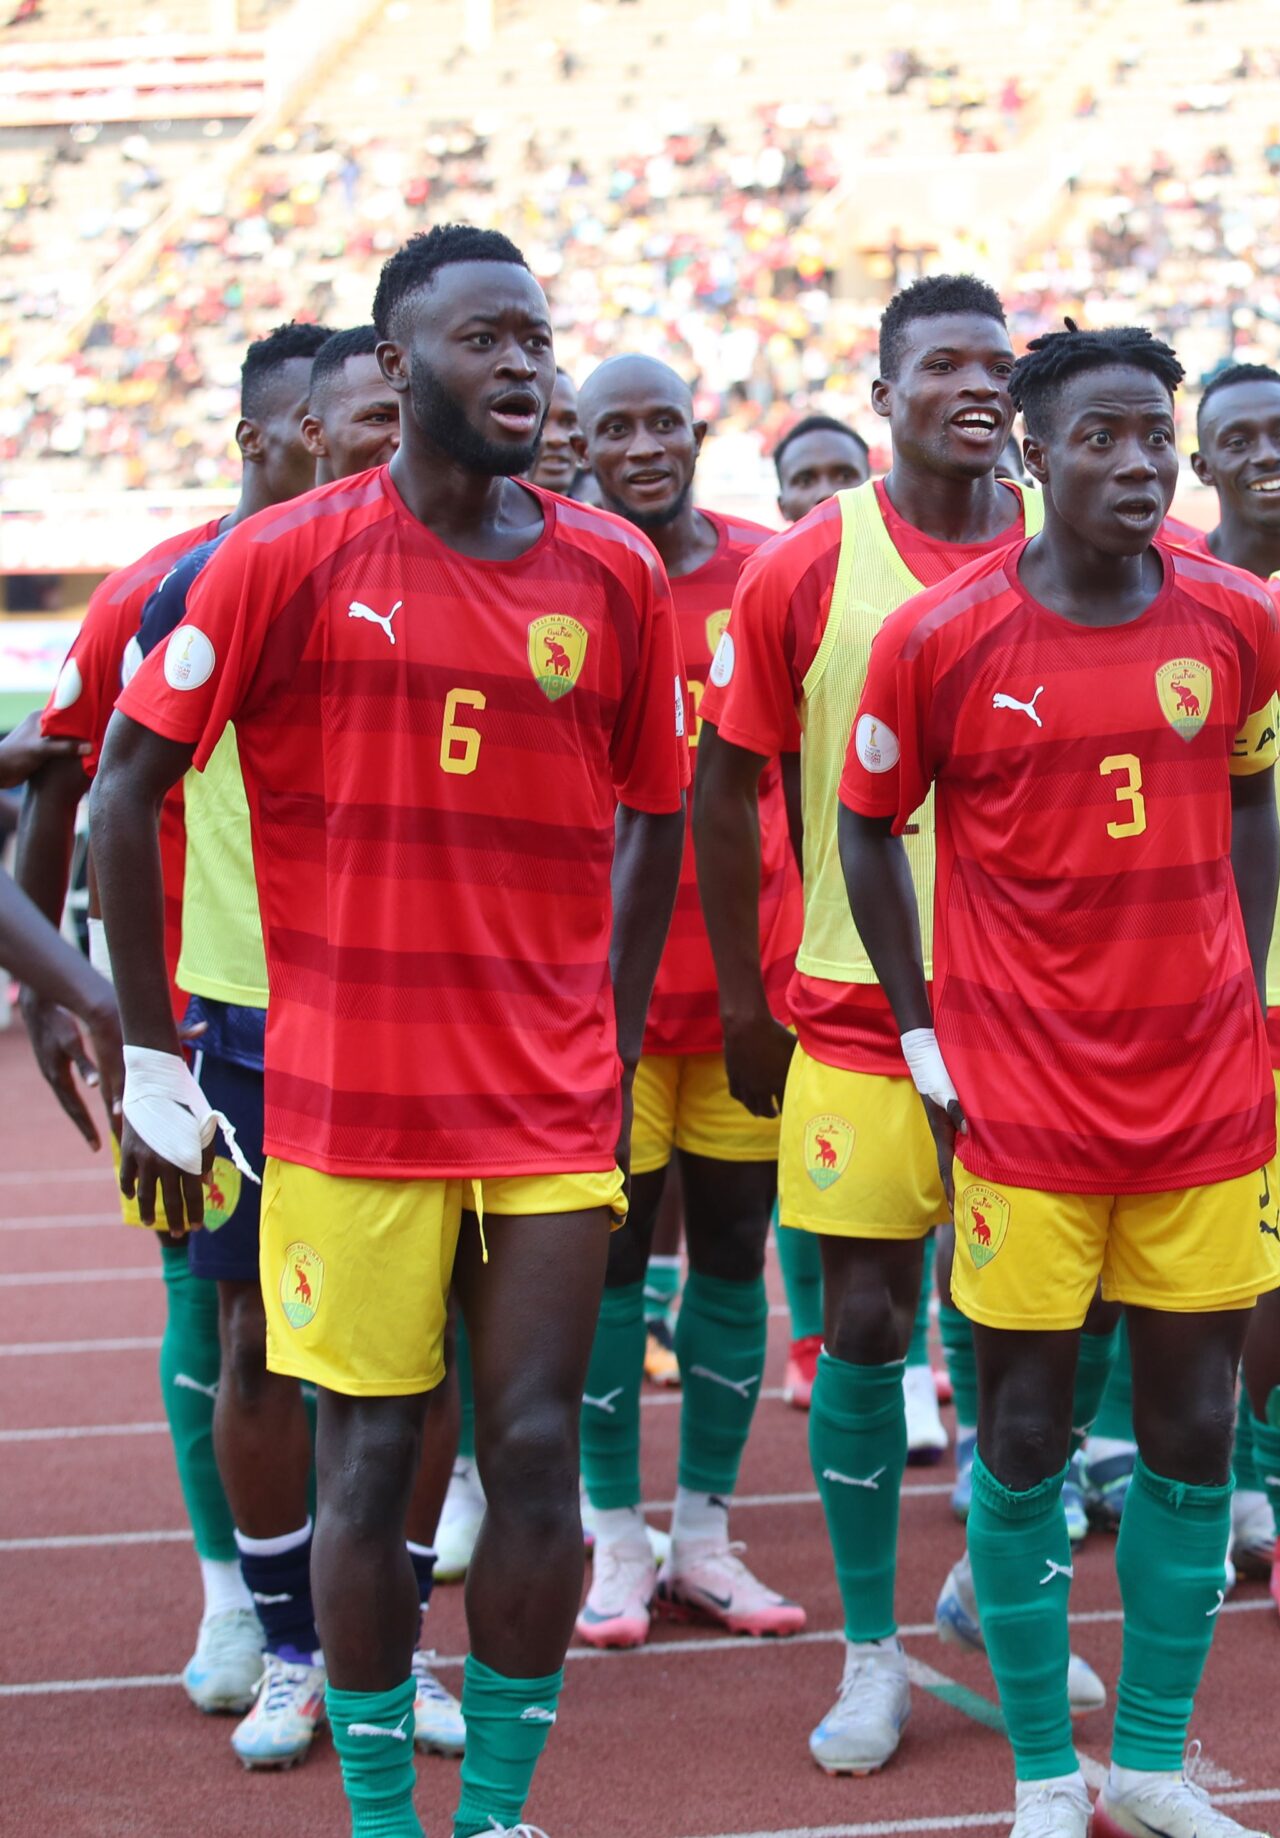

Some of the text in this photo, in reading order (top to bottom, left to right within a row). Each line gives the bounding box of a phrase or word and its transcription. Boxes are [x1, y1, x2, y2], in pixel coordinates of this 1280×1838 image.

[550, 616, 586, 636] NATIONAL
[1172, 660, 1209, 674] NATIONAL
[439, 687, 487, 775] 6
[1099, 753, 1147, 839] 3
